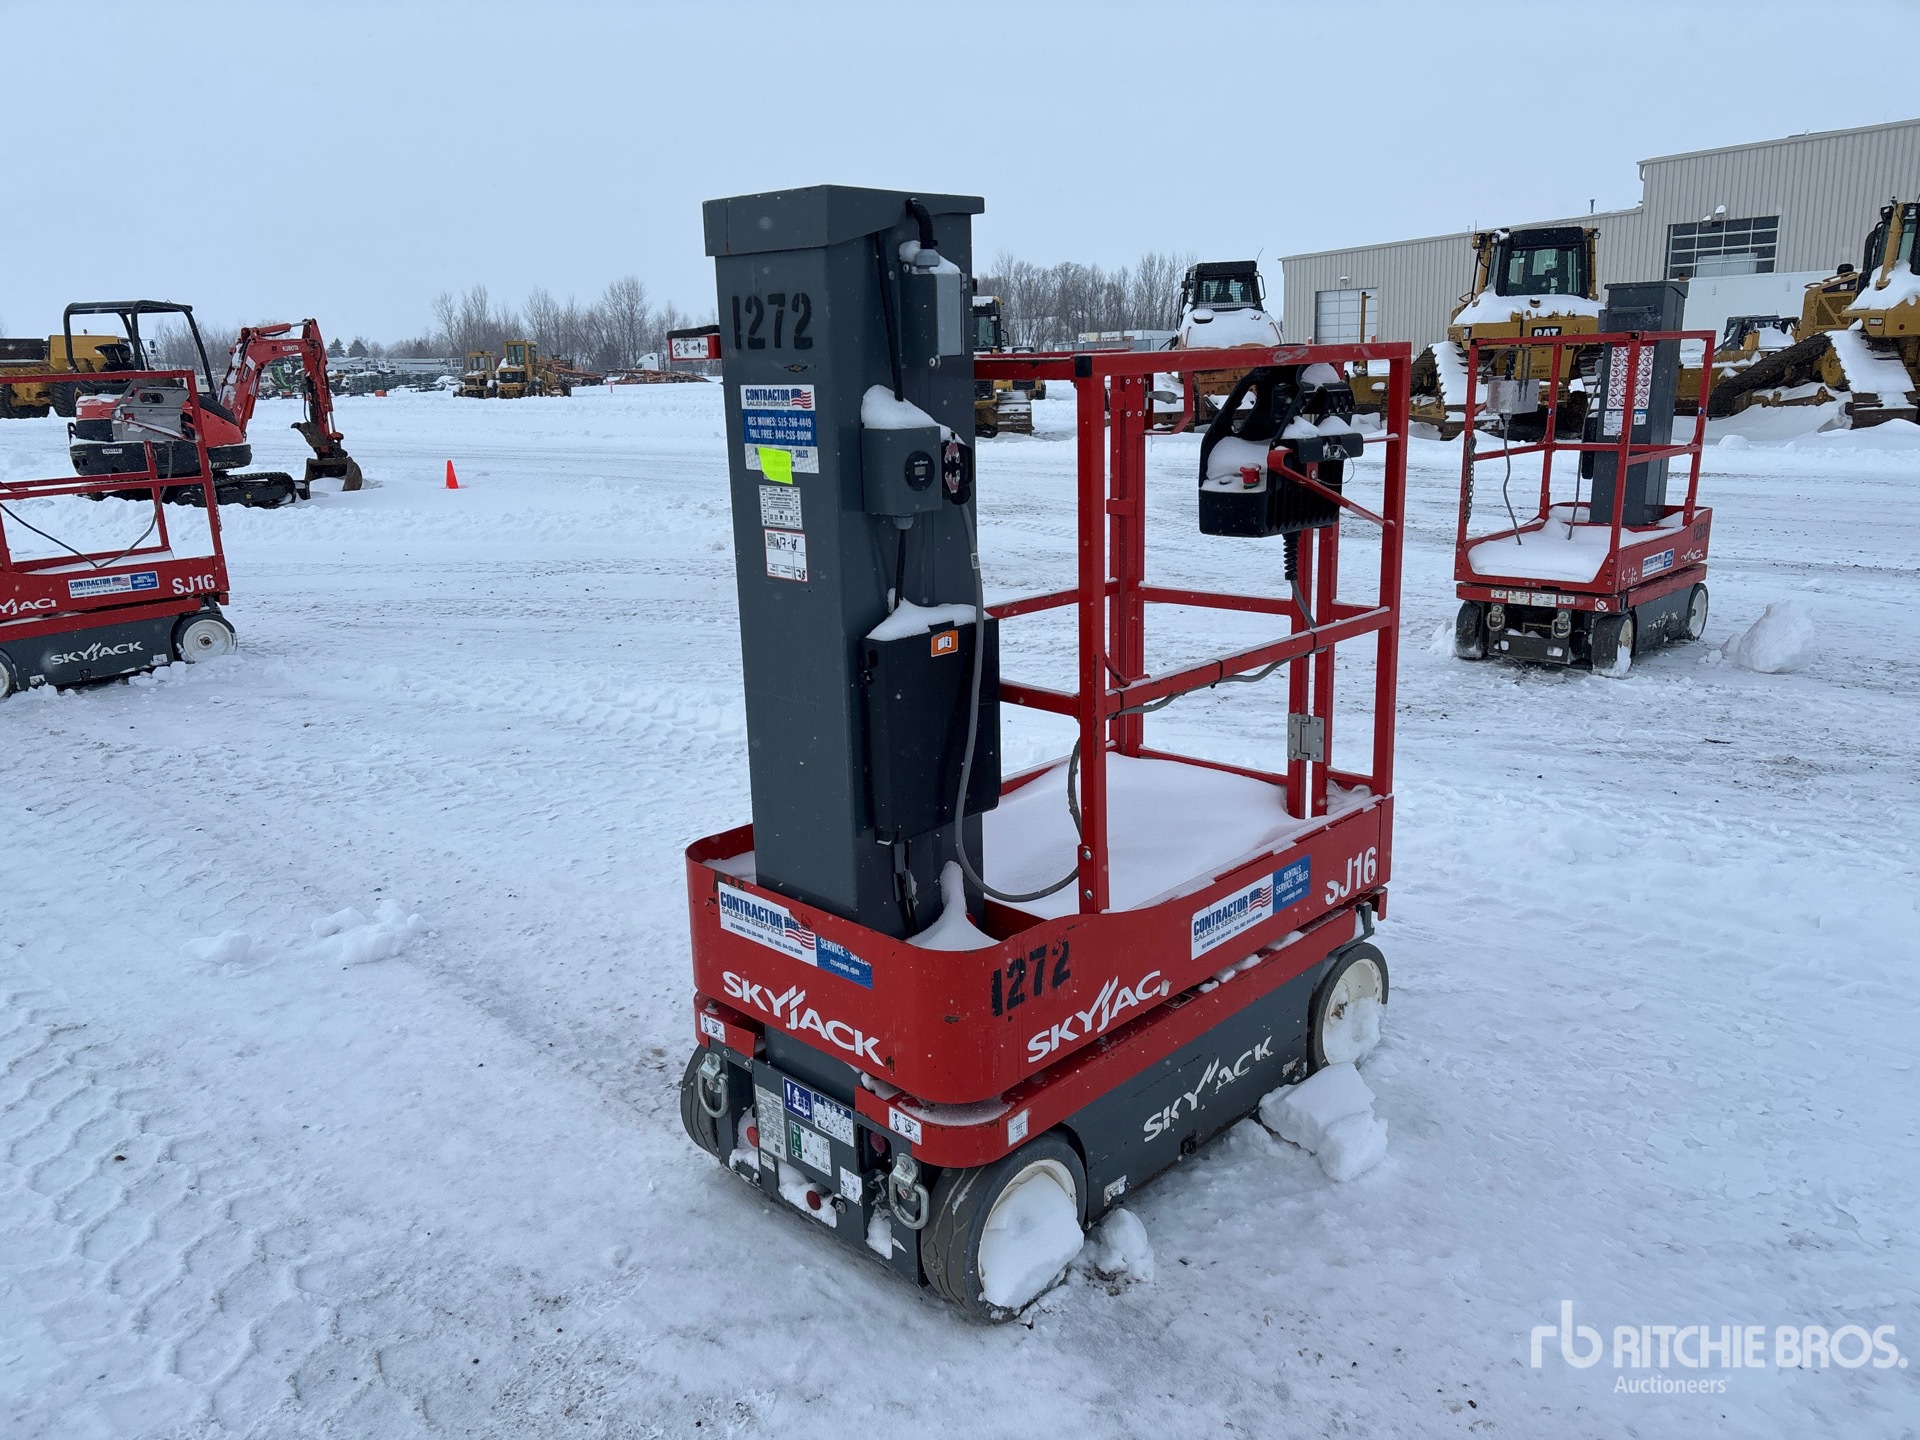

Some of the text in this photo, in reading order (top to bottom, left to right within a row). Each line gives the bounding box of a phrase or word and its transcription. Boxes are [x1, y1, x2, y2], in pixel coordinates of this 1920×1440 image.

[732, 292, 813, 350] 1272
[745, 388, 790, 400] CONTRACTOR
[747, 416, 757, 426] DES
[757, 416, 777, 427] MOINES:
[749, 429, 761, 439] TOLL
[761, 429, 774, 440] FREE:
[796, 449, 809, 459] SALES
[70, 578, 111, 589] CONTRACTOR
[172, 574, 215, 595] SJ16
[50, 641, 144, 666] SKYJACK
[1275, 879, 1294, 896] SERVICE
[1325, 846, 1377, 906] SJ16
[720, 891, 784, 930] CONTRACTOR
[721, 906, 784, 937] SALES & SERVICE
[1193, 895, 1248, 936] CONTRACTOR
[1194, 908, 1248, 943] SALES & SERVICE
[820, 937, 845, 957] SERVICE
[991, 938, 1071, 1017] 1272
[722, 970, 885, 1067] SKYJACK
